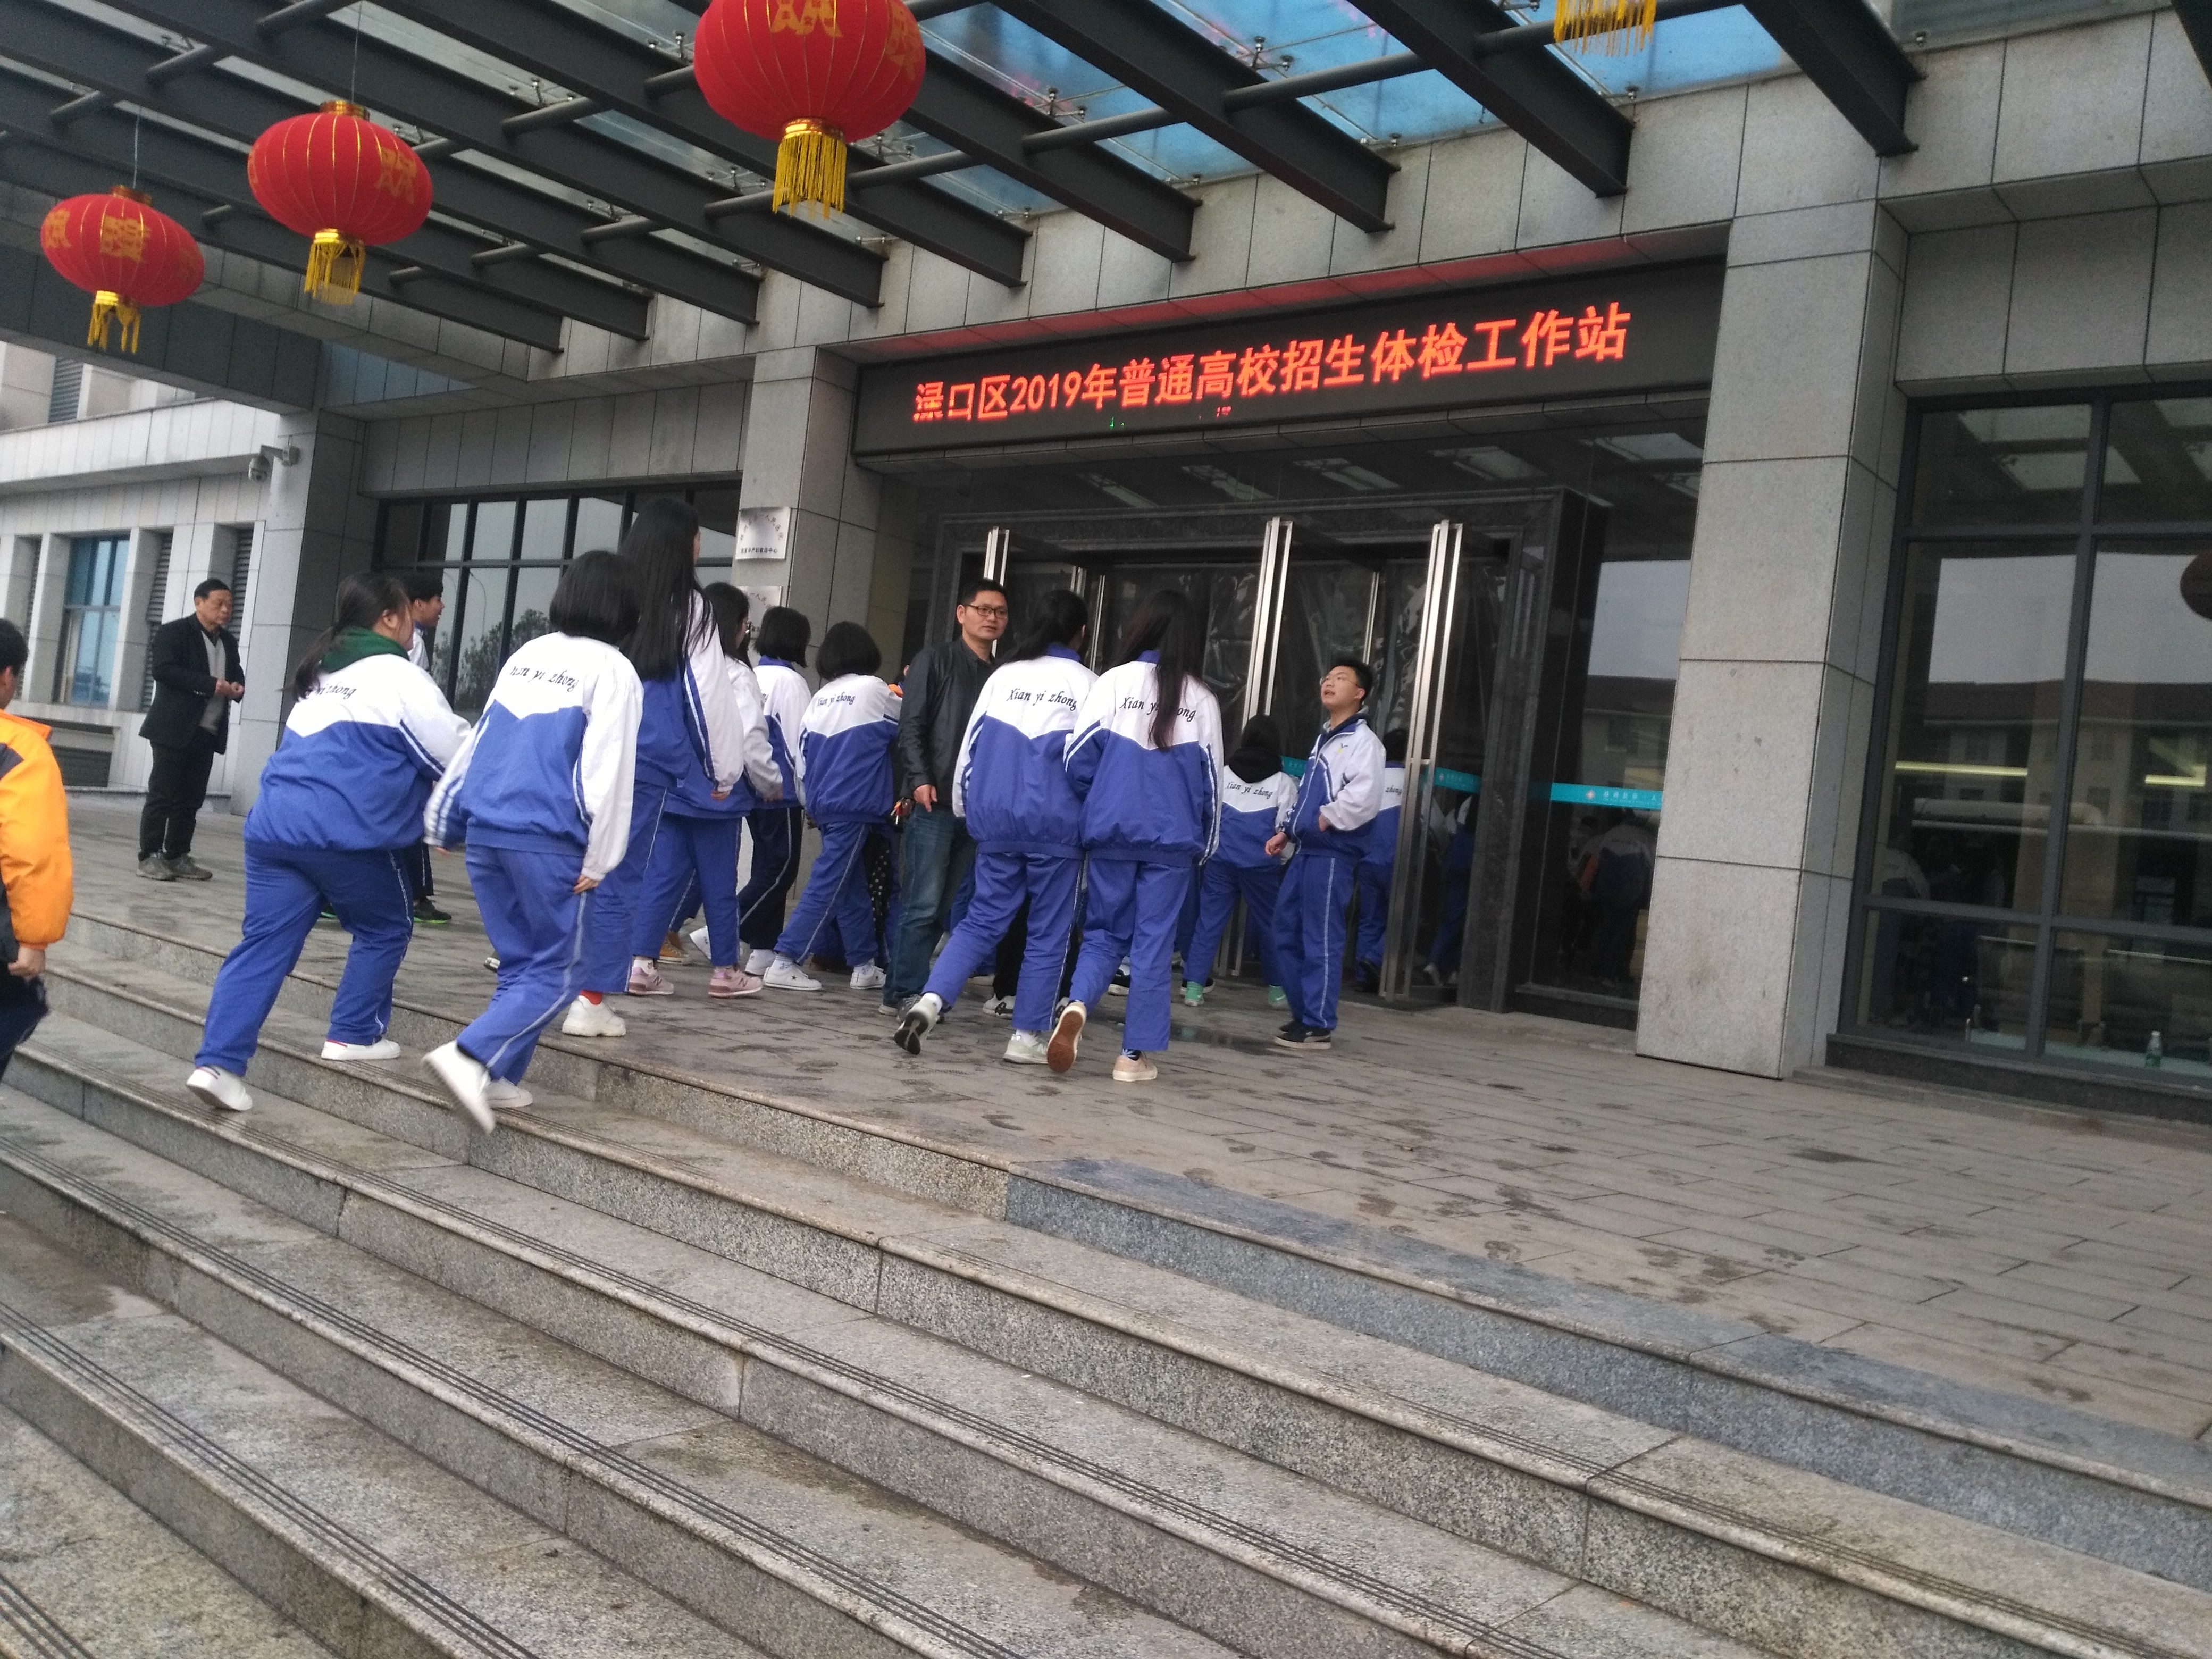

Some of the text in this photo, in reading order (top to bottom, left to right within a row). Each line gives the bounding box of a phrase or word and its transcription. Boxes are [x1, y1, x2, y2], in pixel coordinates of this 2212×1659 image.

[547, 669, 579, 692] zhong
[836, 691, 856, 705] zhong
[1006, 688, 1077, 711] Xian yi zhong
[1119, 697, 1145, 710] Xian
[1176, 707, 1197, 722] ong
[1241, 785, 1253, 794] yi
[1253, 787, 1273, 800] zhong
